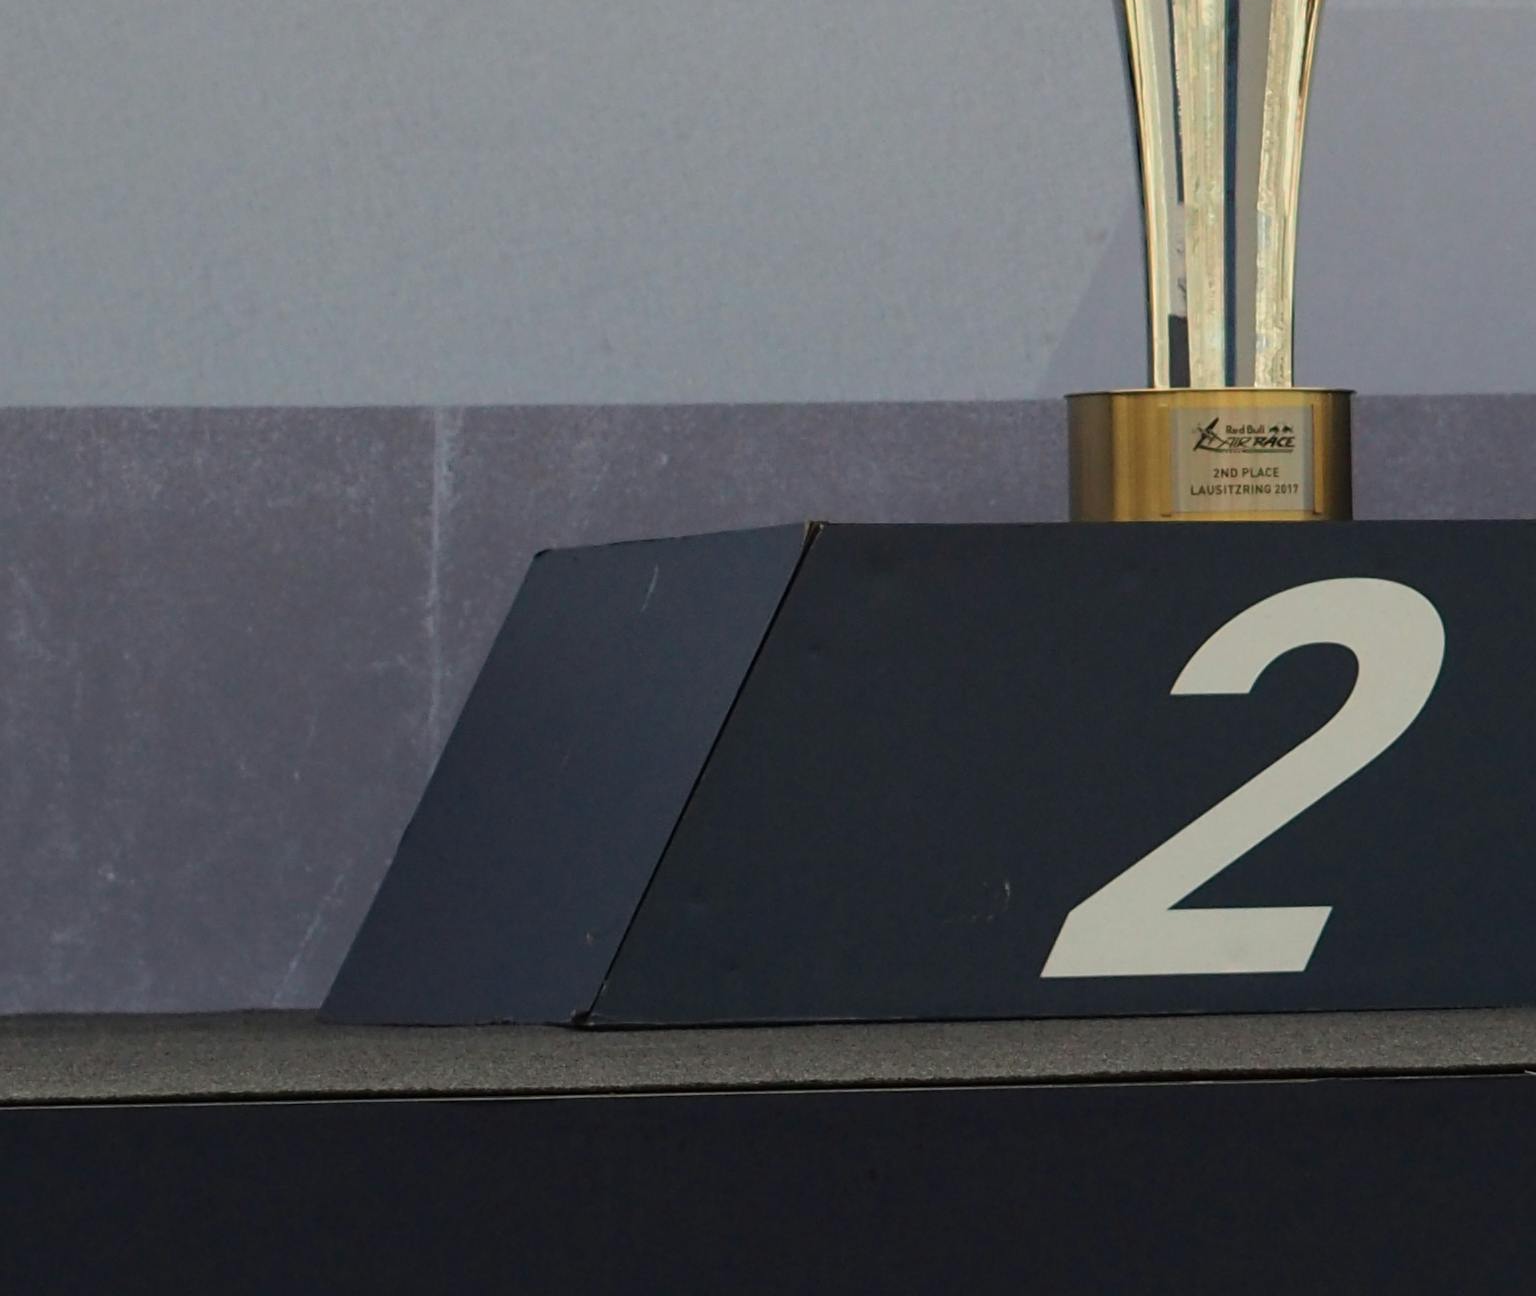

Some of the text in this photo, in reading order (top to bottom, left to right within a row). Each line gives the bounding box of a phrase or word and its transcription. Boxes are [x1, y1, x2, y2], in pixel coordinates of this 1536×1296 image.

[1225, 425, 1265, 434] Red Bull
[1253, 436, 1295, 448] RACE
[1213, 467, 1279, 478] 2ND PLACE
[1190, 484, 1298, 496] LAUSITZRING 2017
[1041, 577, 1446, 978] 2
